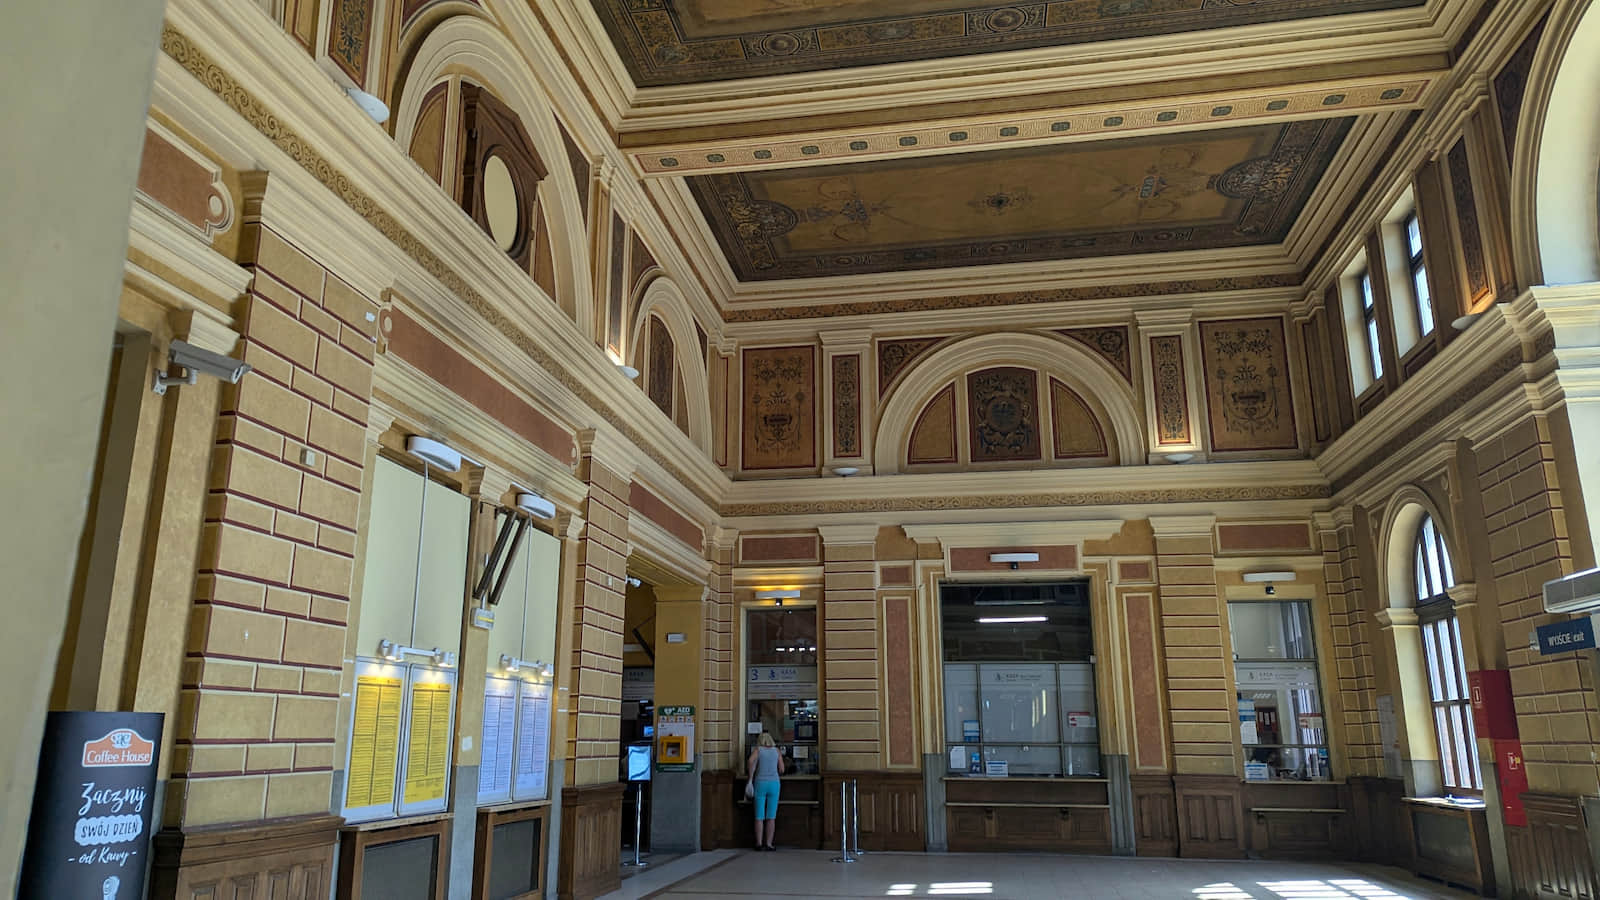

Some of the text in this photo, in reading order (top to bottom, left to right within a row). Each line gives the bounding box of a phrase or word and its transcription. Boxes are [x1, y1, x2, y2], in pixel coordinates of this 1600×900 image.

[1573, 632, 1584, 641] exit
[751, 669, 759, 680] 3
[86, 749, 150, 763] Coffee House
[78, 782, 147, 816] Zacznij
[81, 821, 110, 838] SWÓJ
[79, 846, 129, 867] od Kawy
